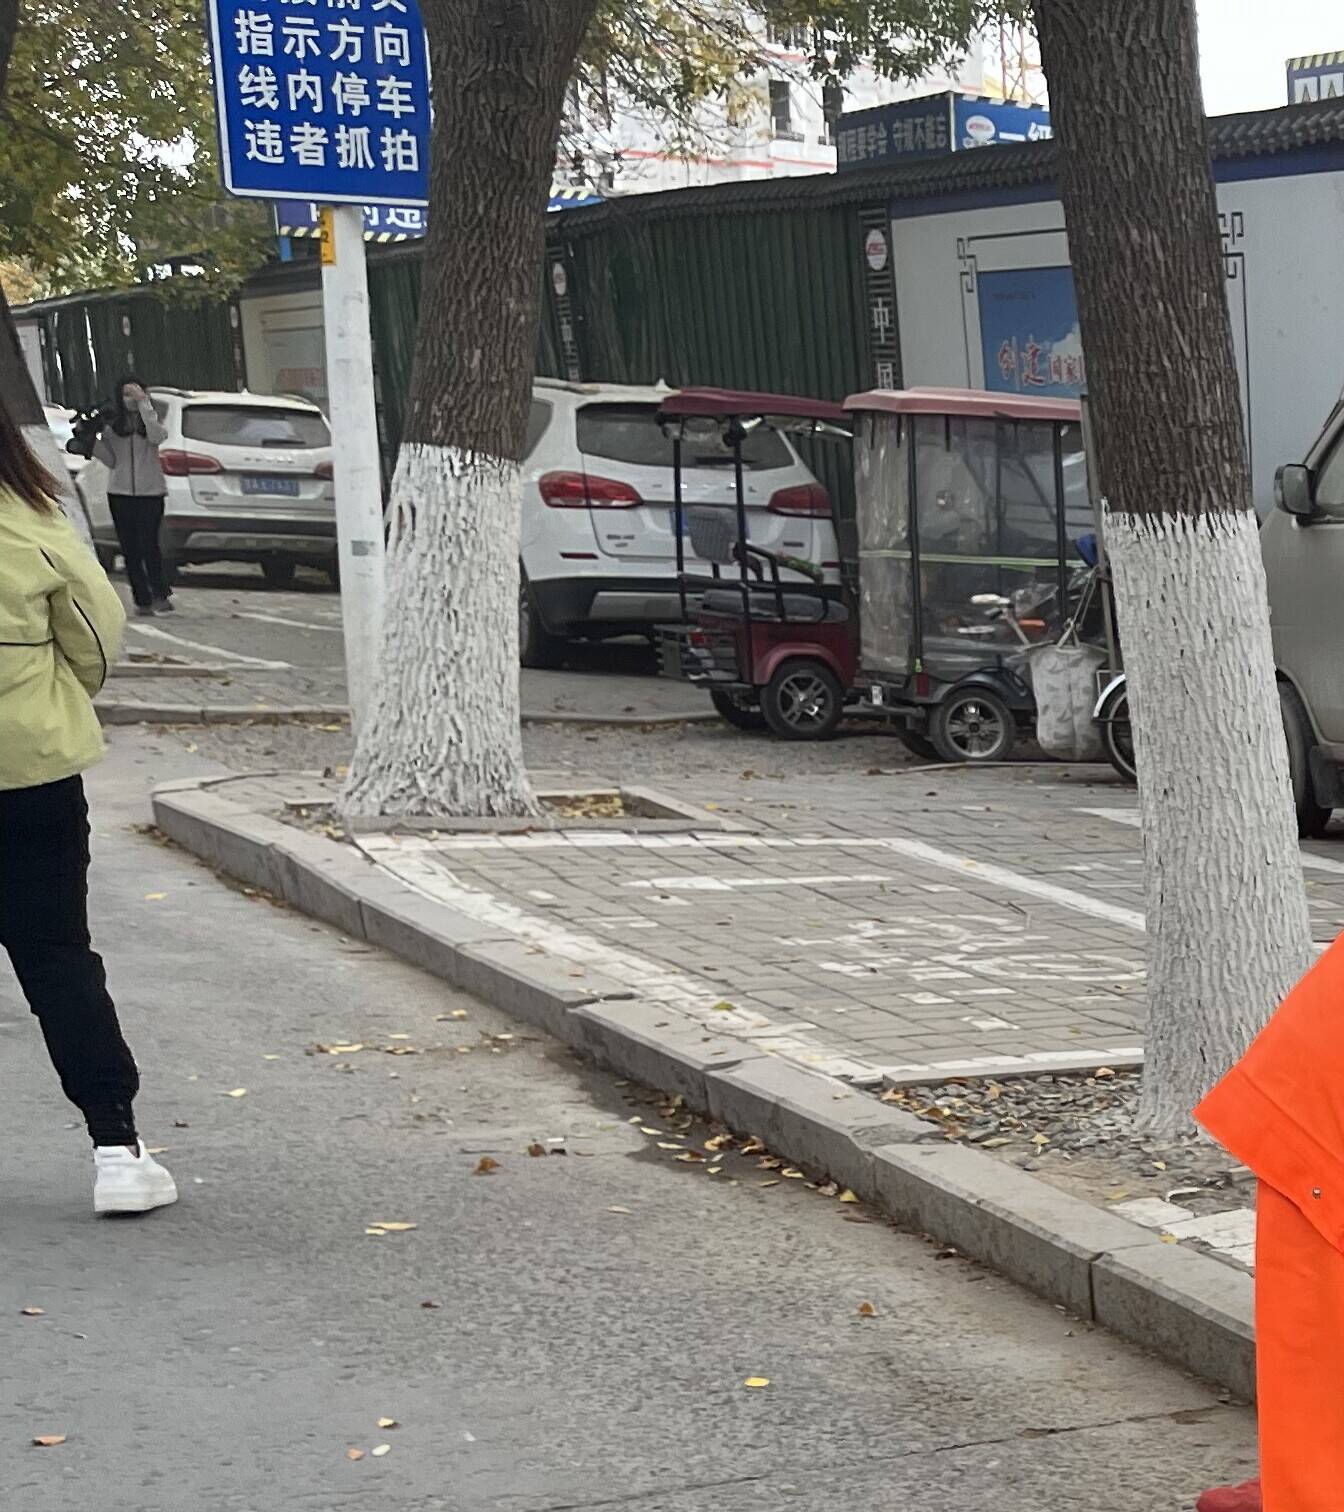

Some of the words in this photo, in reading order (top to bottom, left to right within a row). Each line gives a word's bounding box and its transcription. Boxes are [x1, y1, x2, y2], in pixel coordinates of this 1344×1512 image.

[234, 9, 411, 67] 指示方向
[238, 64, 416, 119] 线内停车
[244, 119, 419, 172] 违者抓拍
